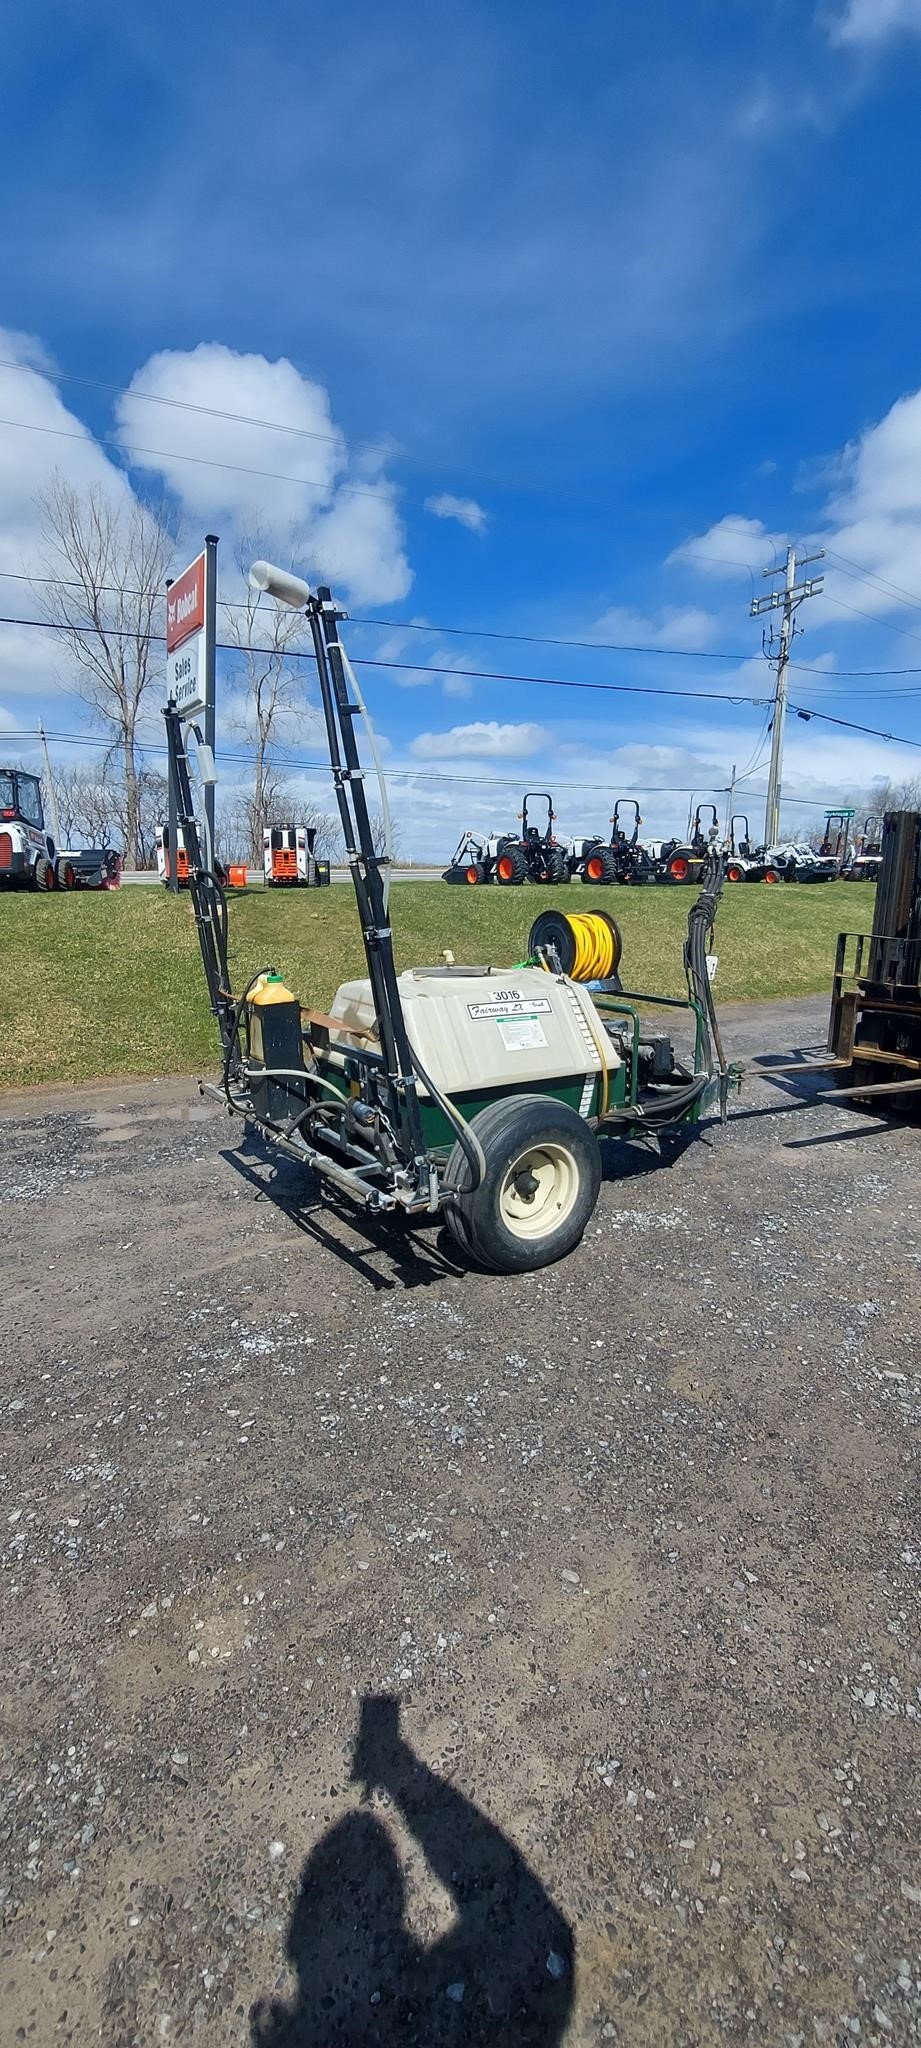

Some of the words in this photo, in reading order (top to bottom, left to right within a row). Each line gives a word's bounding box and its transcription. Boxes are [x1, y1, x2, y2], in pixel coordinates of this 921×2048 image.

[177, 583, 197, 624] Bobcat
[175, 657, 191, 681] Sales
[175, 676, 196, 702] Service
[493, 990, 520, 1000] 3016
[472, 1005, 508, 1016] Fairway
